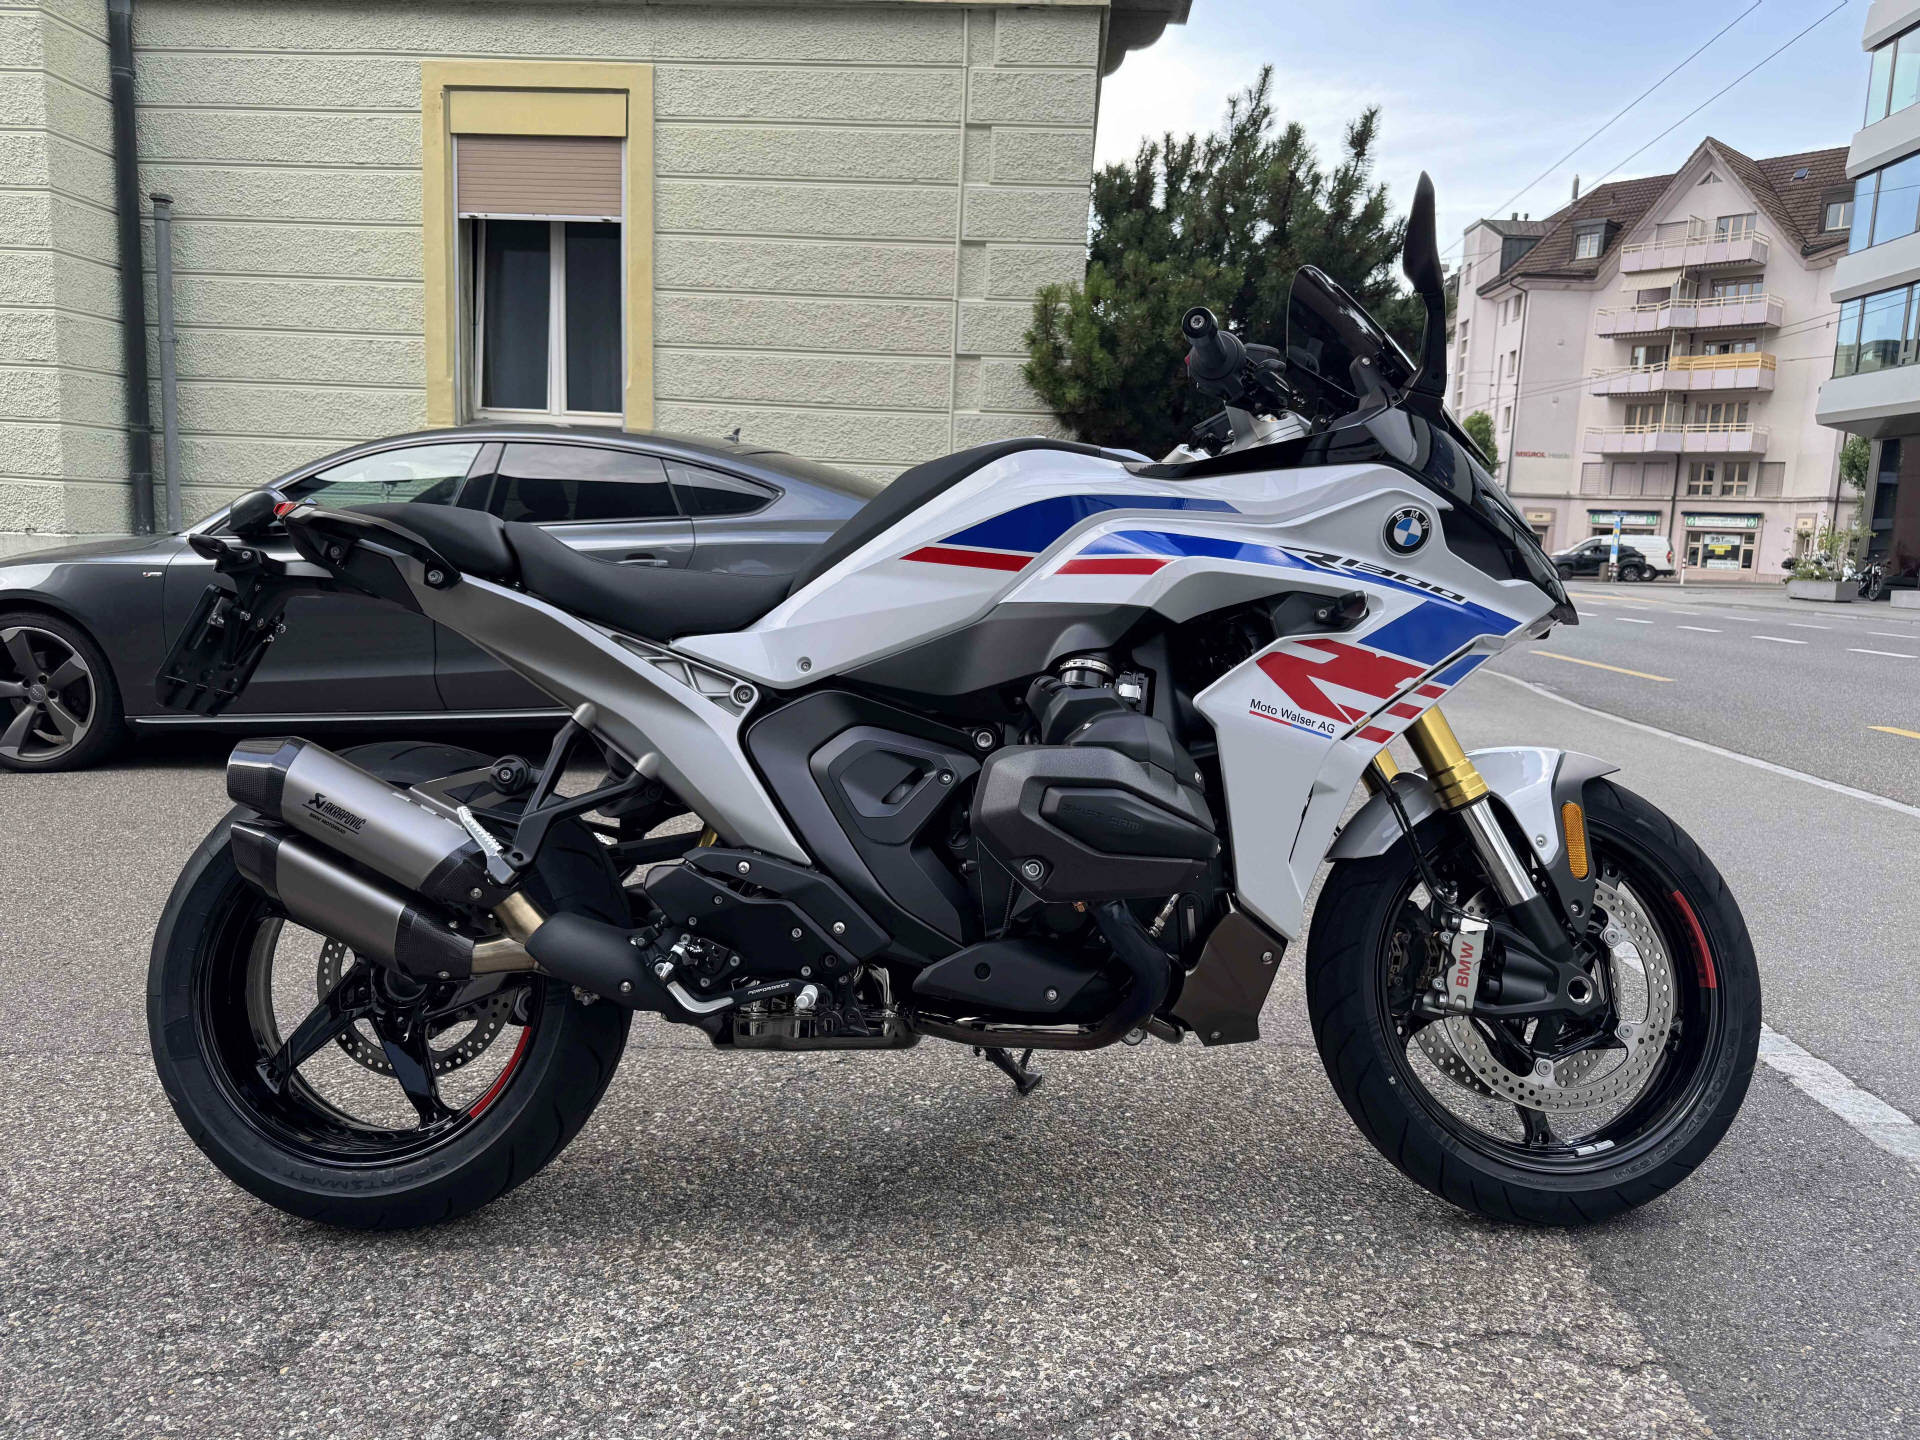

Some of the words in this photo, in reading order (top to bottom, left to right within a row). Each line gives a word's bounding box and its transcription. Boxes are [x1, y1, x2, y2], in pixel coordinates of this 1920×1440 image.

[1395, 510, 1430, 529] BMW
[1249, 698, 1278, 715] Moto
[1280, 707, 1317, 728] Walser
[1317, 721, 1336, 734] AG
[1455, 941, 1474, 988] BMW
